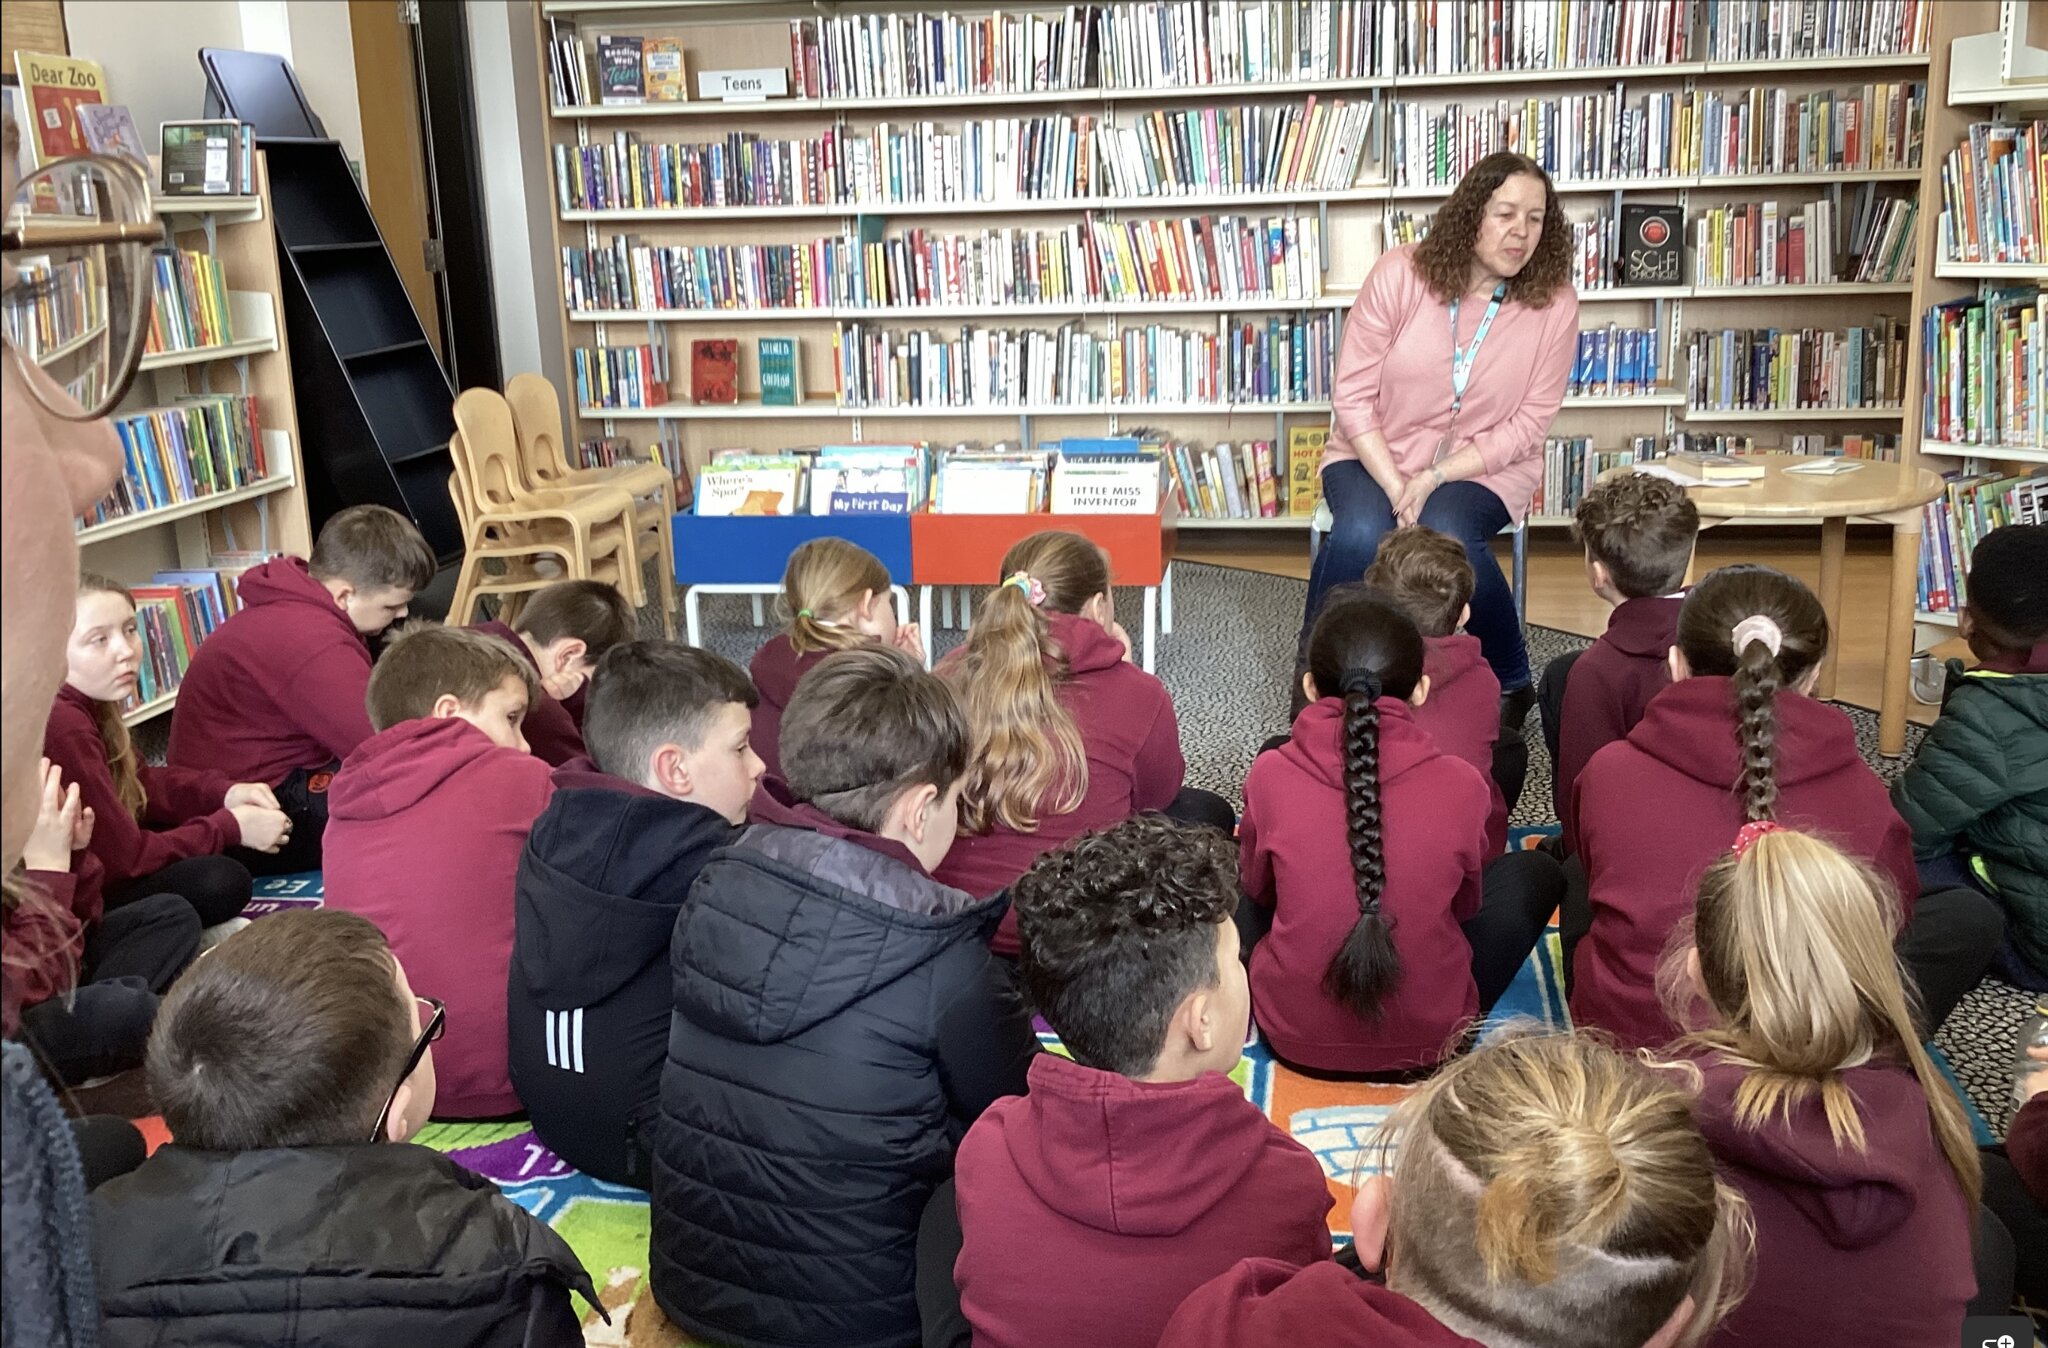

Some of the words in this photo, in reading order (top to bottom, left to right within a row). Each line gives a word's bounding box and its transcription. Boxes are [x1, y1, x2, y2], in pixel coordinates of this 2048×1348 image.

[604, 47, 641, 61] Reading
[613, 57, 633, 66] Well
[30, 62, 64, 86] Dear
[67, 65, 97, 88] Zoo
[722, 76, 762, 92] Teens
[1846, 102, 1855, 130] NEIN
[706, 474, 753, 487] Where's
[1070, 486, 1108, 495] LITTLE
[1112, 486, 1141, 496] MISS
[833, 498, 850, 512] My
[851, 497, 879, 511] First
[881, 498, 904, 514] Day
[1073, 498, 1137, 507] INVENTOR
